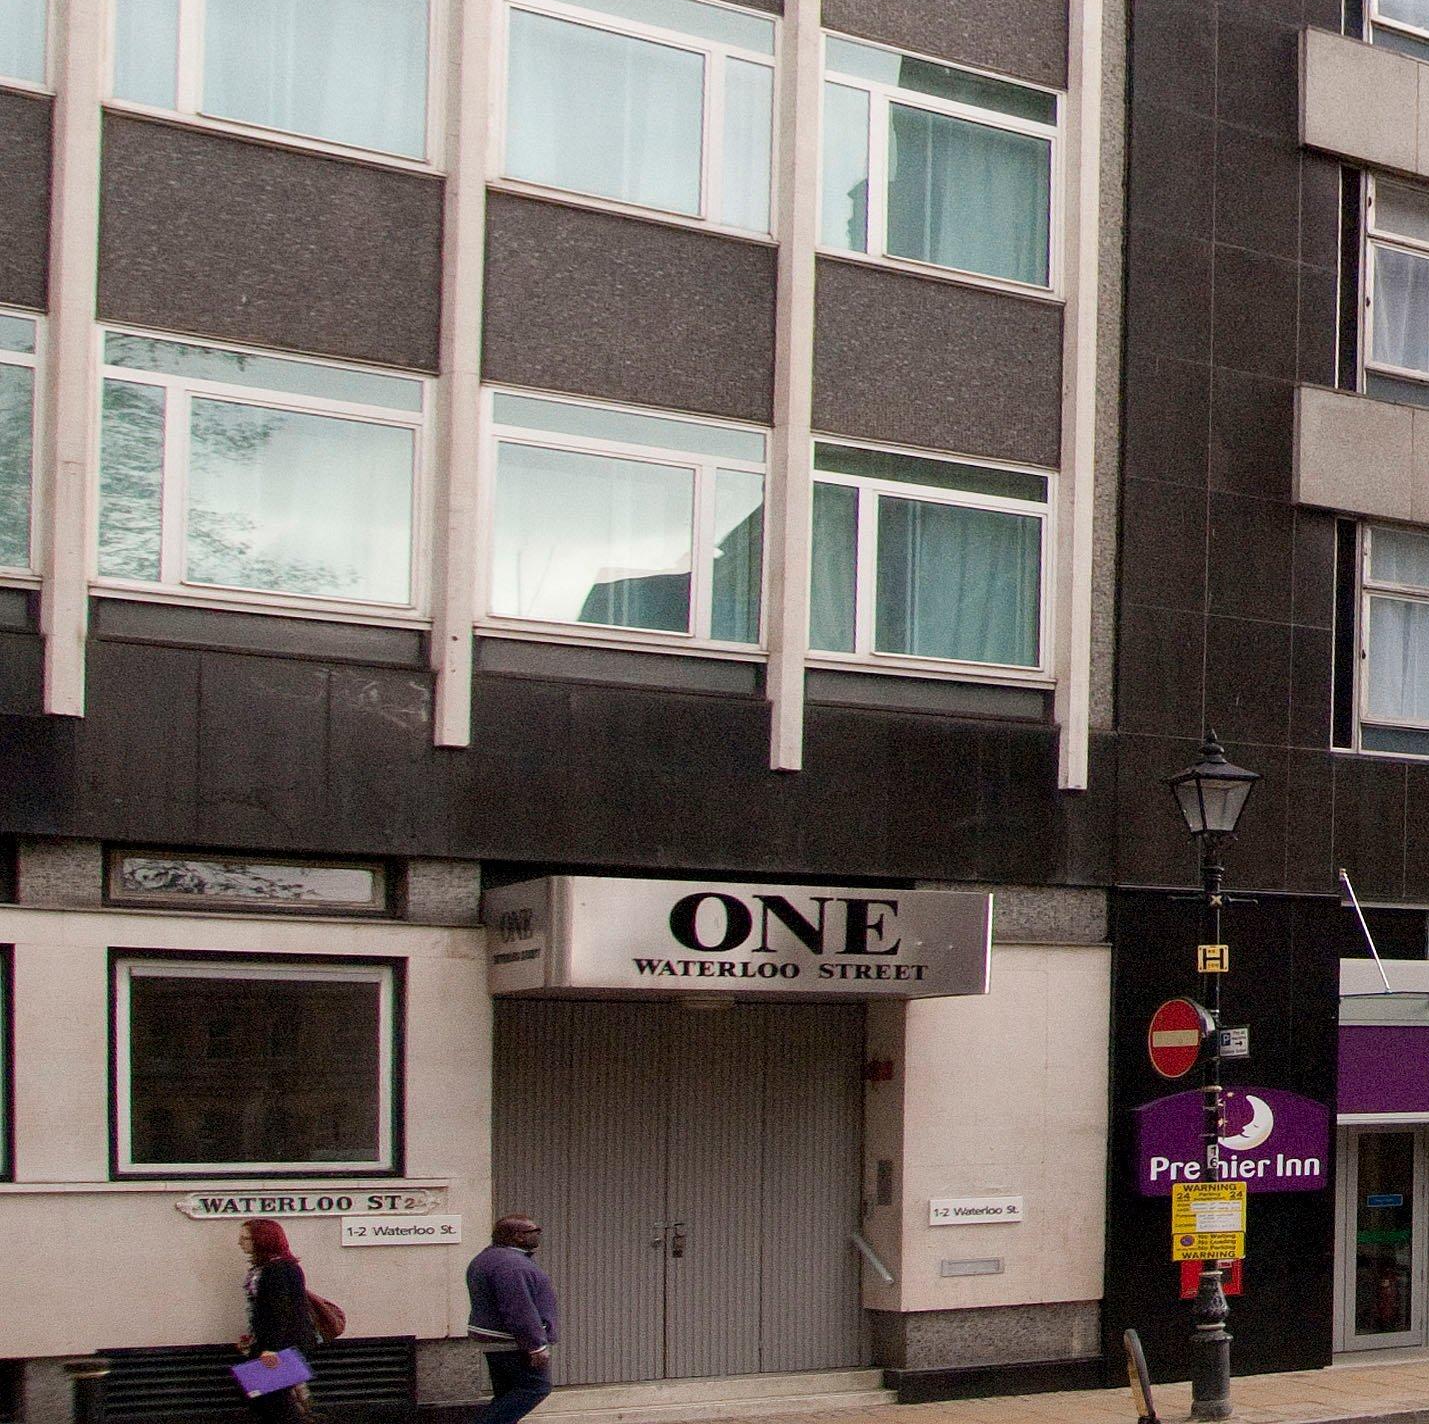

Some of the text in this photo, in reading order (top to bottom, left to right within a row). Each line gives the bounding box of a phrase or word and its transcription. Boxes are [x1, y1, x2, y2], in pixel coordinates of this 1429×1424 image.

[669, 891, 902, 956] ONE
[1202, 948, 1224, 970] H
[633, 958, 929, 982] WATERLOO STREET
[1276, 1153, 1321, 1177] Inn
[1176, 1192, 1190, 1200] 24
[1183, 1183, 1237, 1192] WARNING
[200, 1194, 416, 1214] WATERLOO ST 2
[934, 1207, 951, 1217] 1-2
[952, 1205, 1003, 1216] Waterloo
[346, 1223, 457, 1238] 1-2 Waterloo St.
[1182, 1250, 1236, 1259] WARNING
